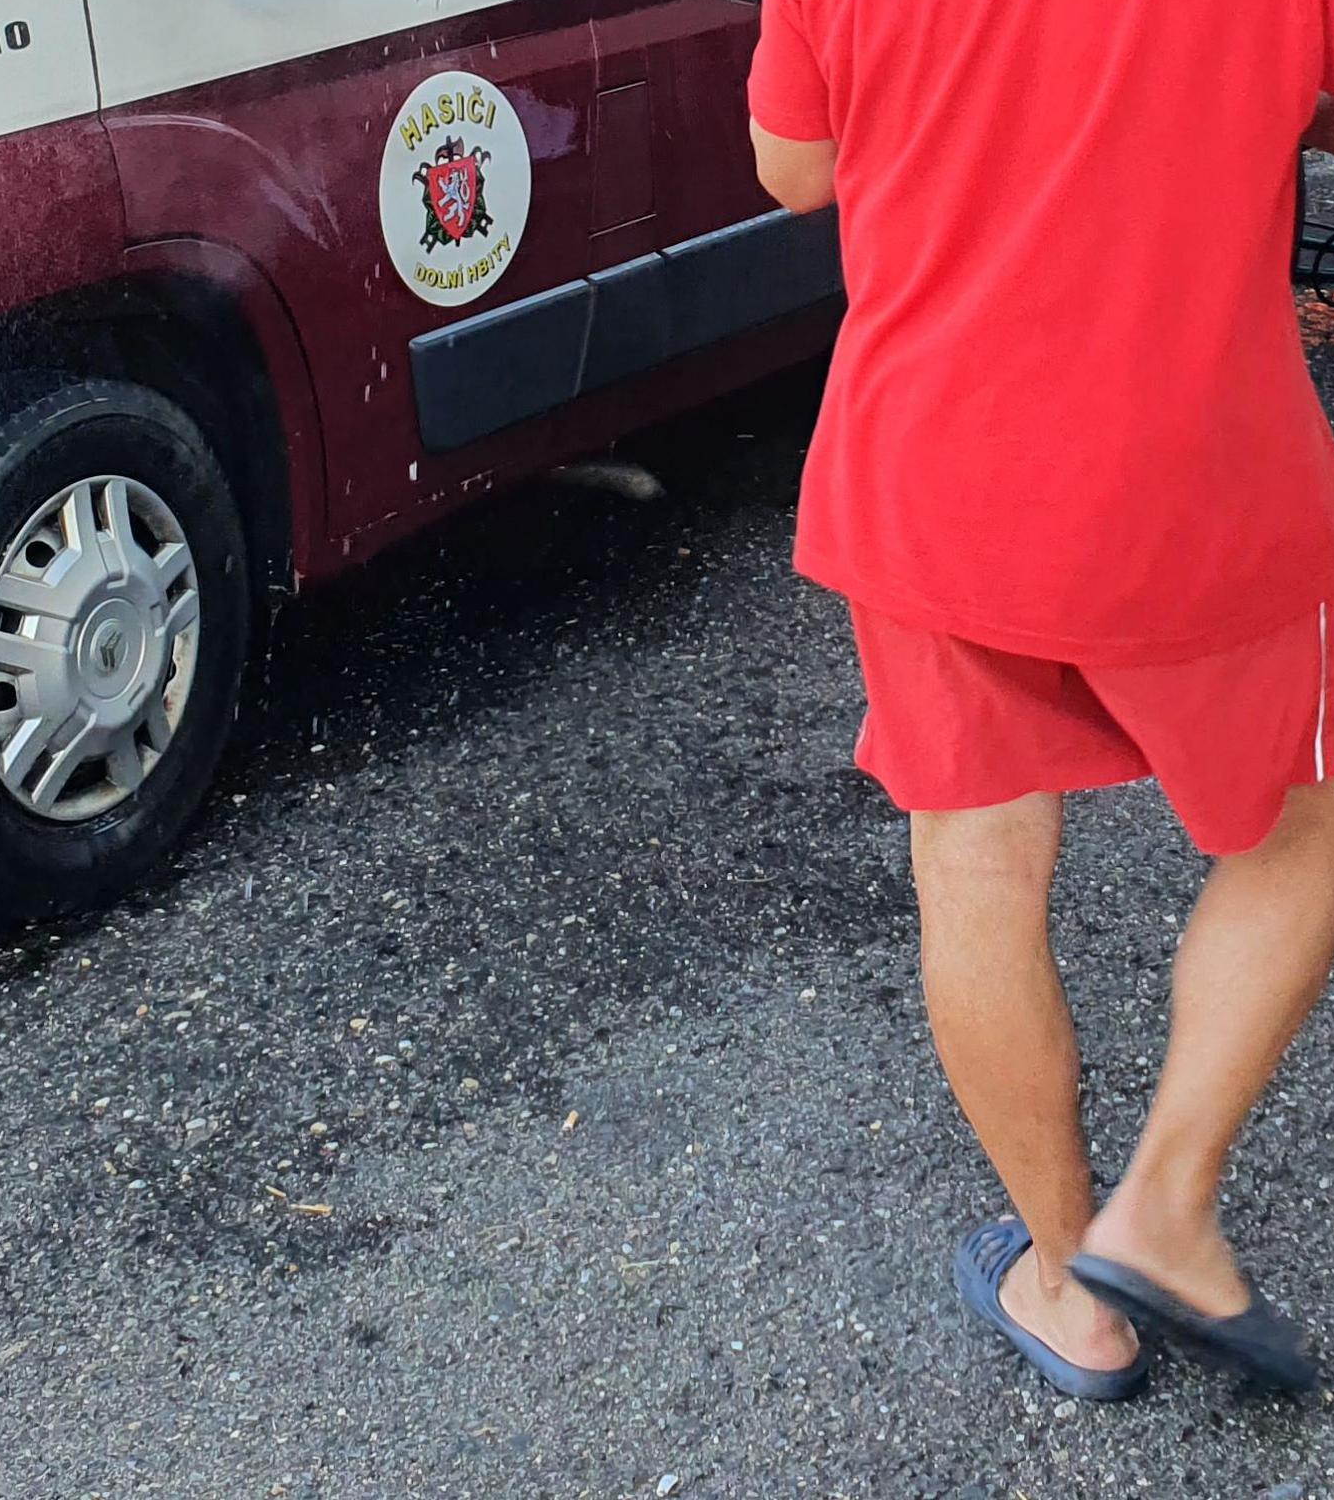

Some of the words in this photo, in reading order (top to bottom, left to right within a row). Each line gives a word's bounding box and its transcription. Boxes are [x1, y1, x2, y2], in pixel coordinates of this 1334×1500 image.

[398, 85, 497, 150] HASIČI
[413, 261, 465, 289] DOLNÍ
[466, 232, 512, 283] HBITY
